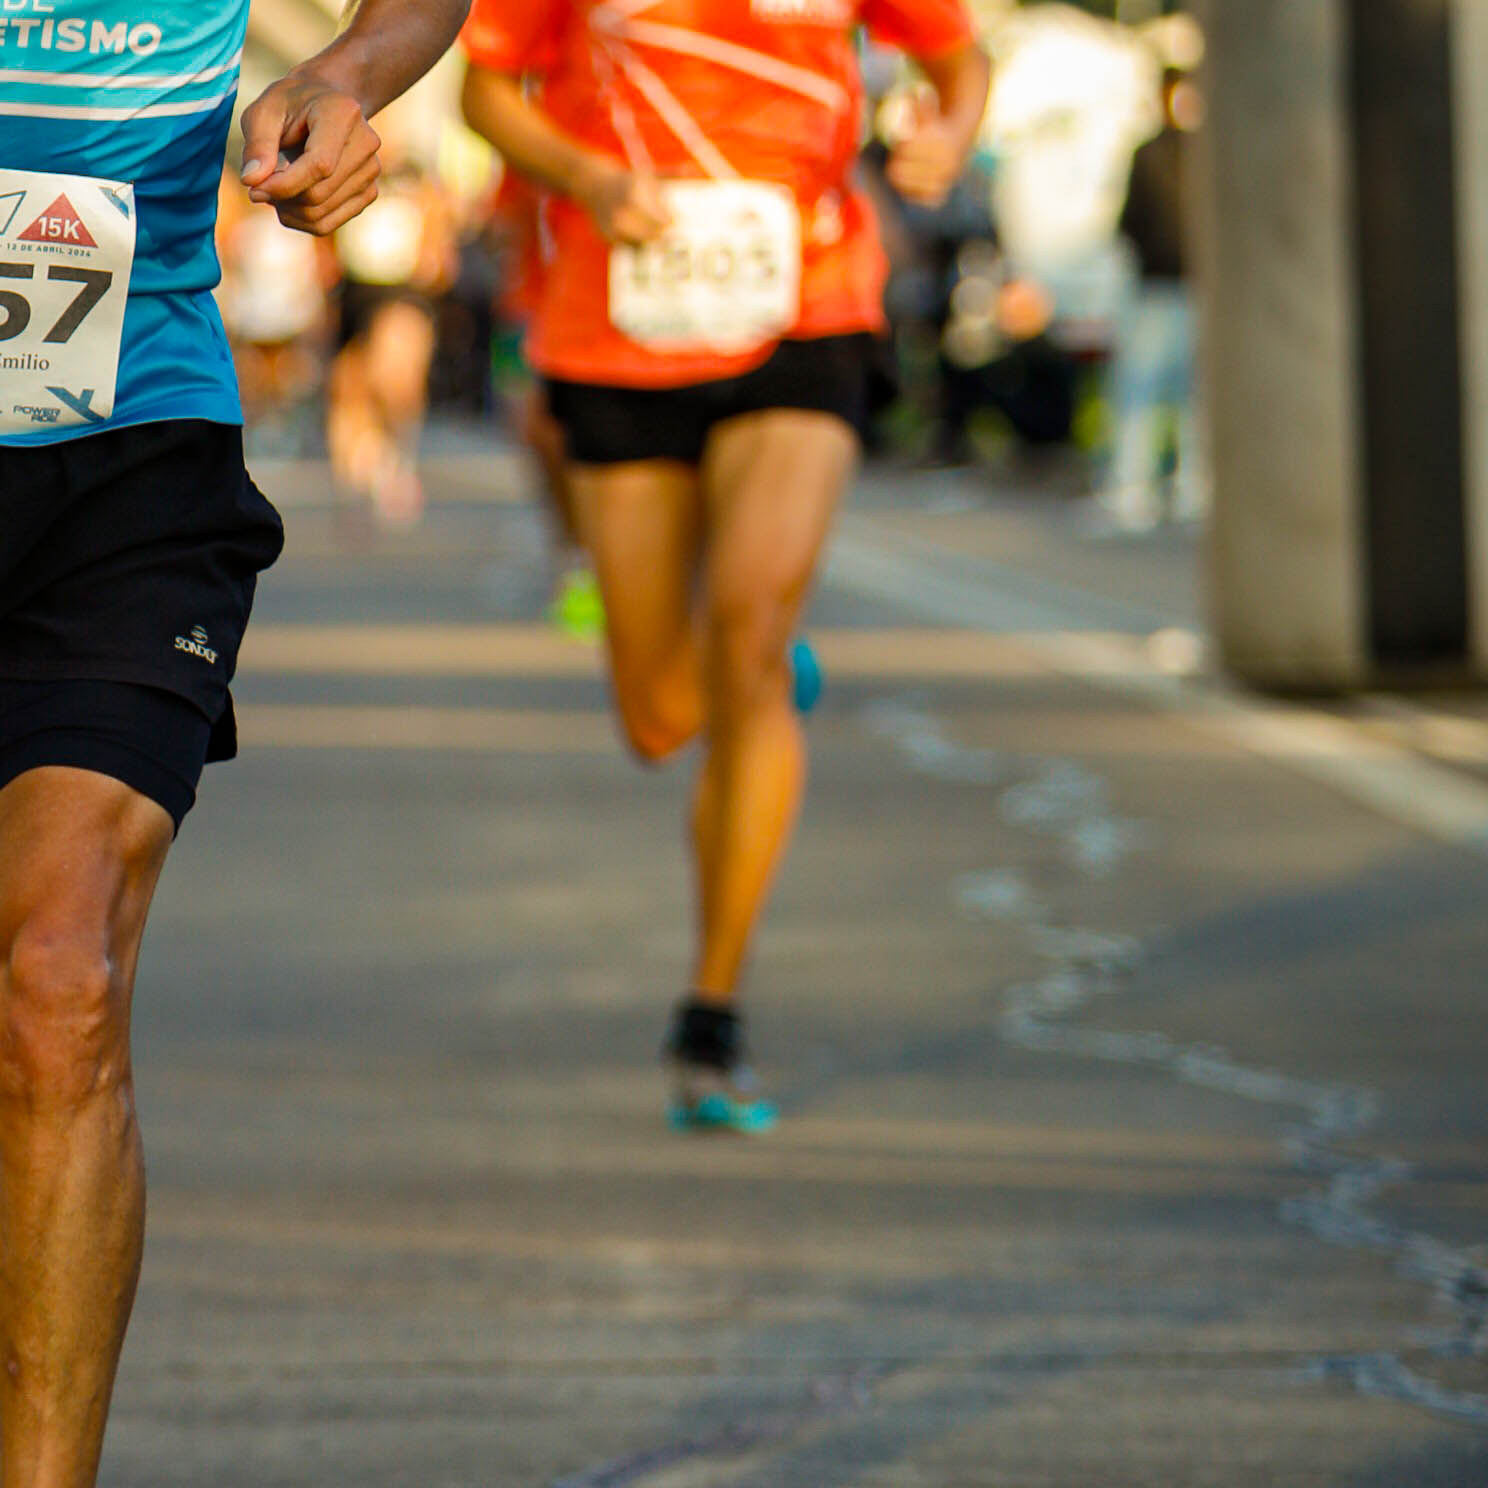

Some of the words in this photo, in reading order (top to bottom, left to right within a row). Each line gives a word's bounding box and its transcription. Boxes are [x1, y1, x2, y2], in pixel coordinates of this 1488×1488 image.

[38, 215, 81, 240] 15K
[20, 243, 32, 252] DE
[36, 244, 65, 255] ABRIL
